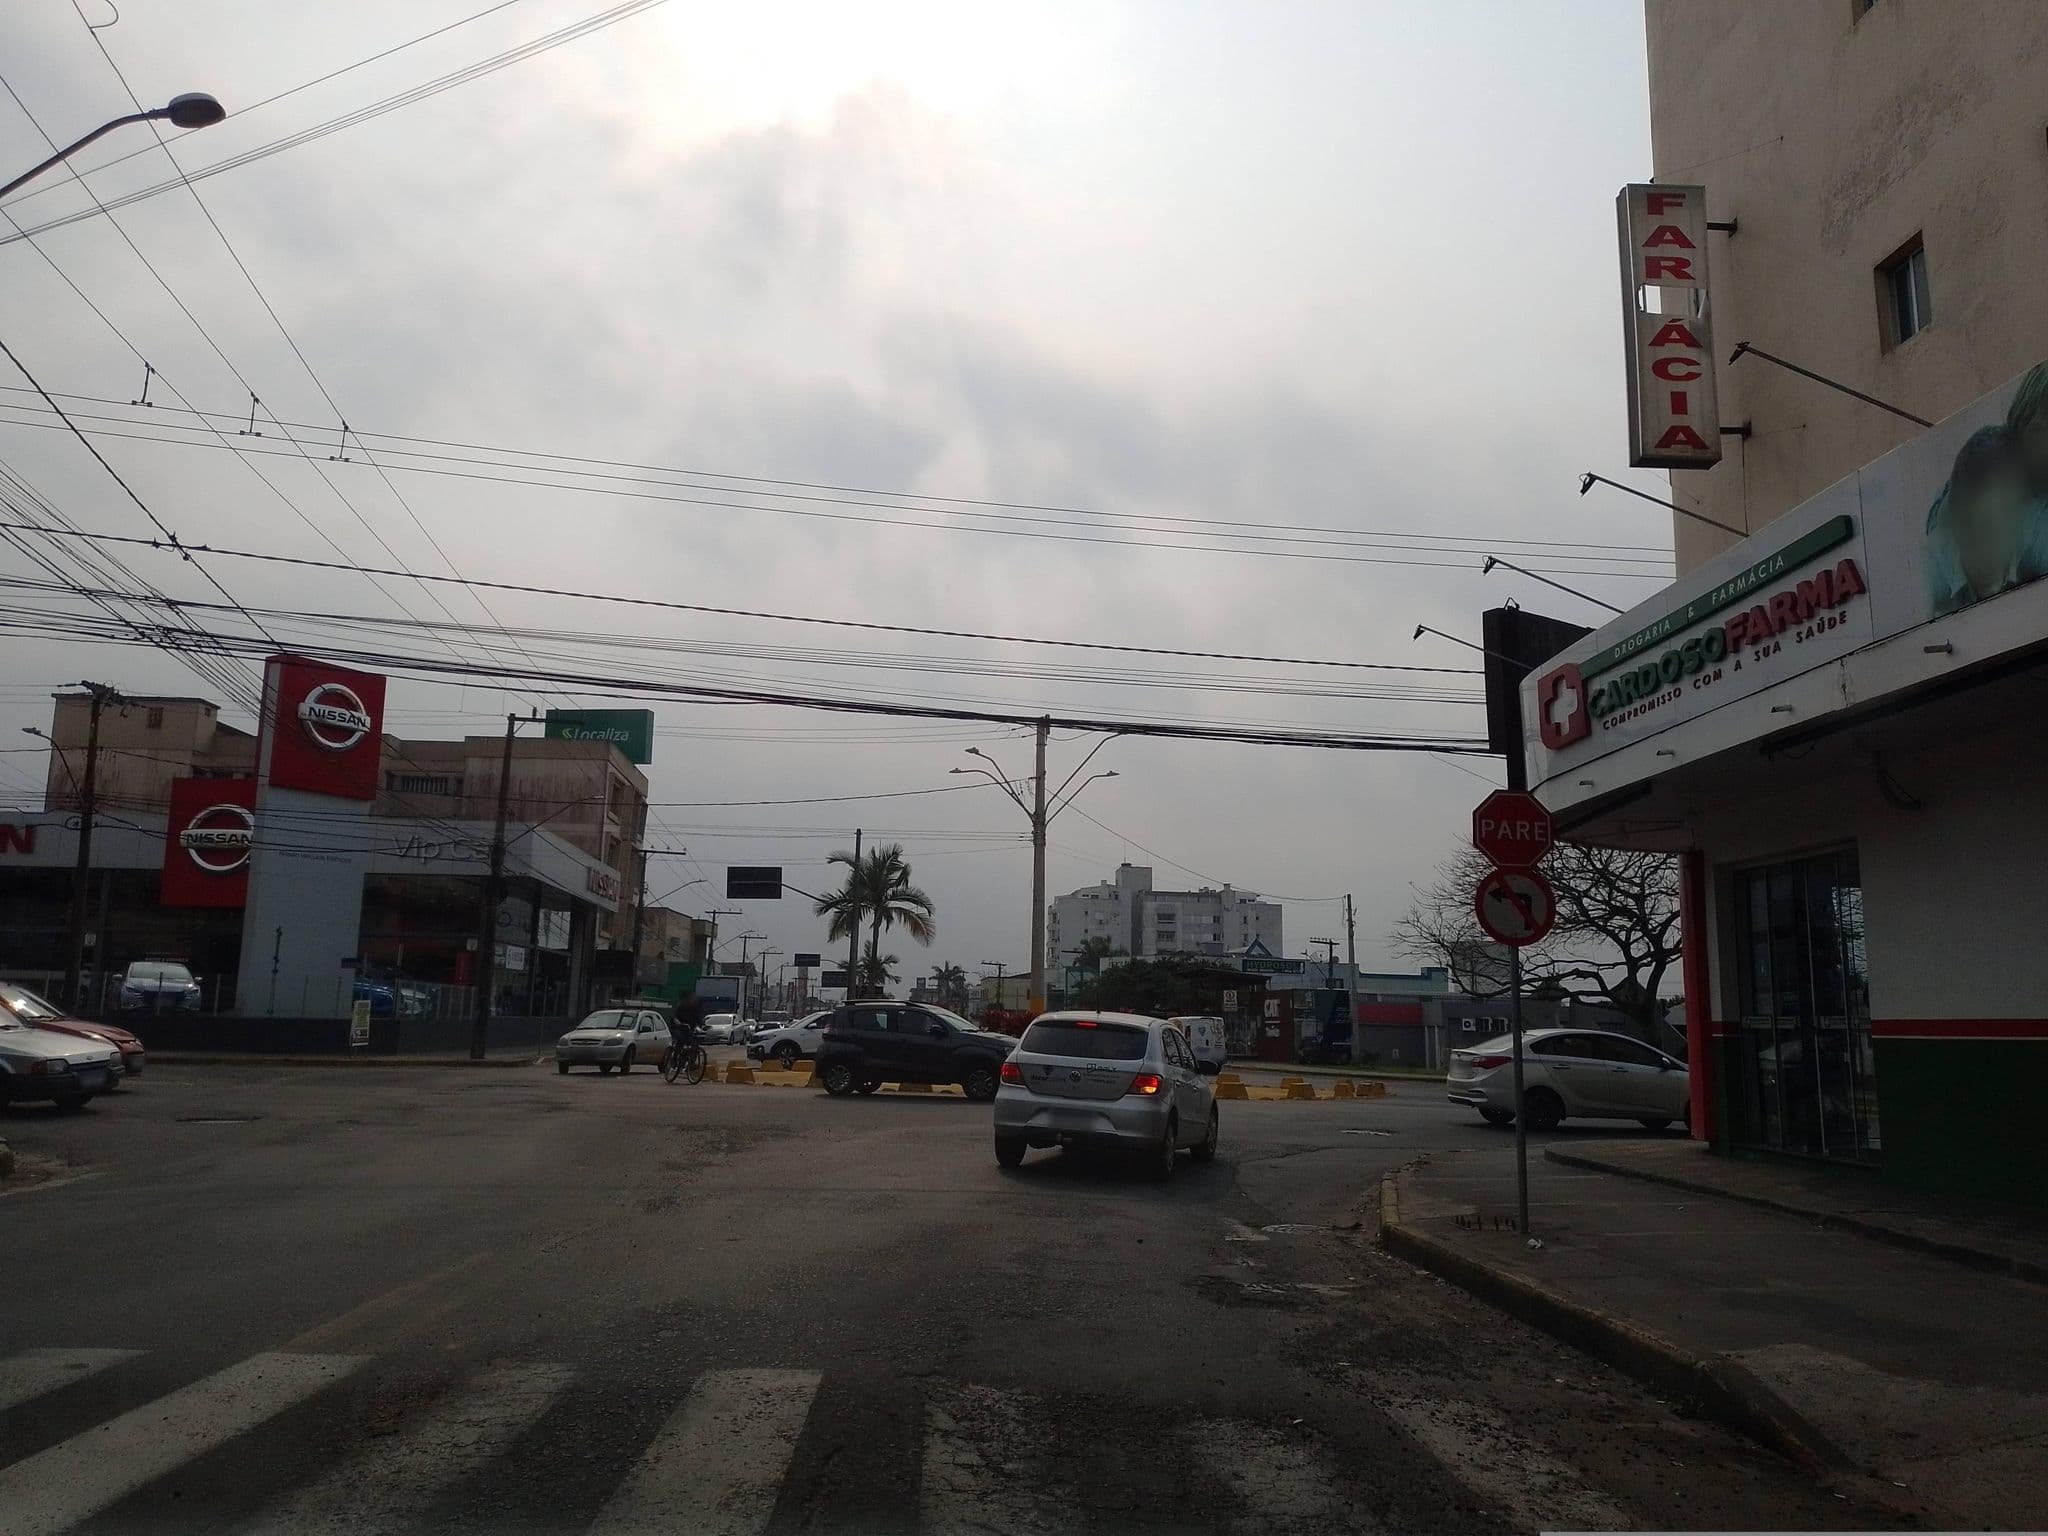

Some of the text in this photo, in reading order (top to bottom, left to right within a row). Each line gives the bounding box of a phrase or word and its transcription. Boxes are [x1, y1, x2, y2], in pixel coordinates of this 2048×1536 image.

[1642, 193, 1711, 449] FARÁCIA
[1614, 555, 1785, 658] DROGARIA & FARMÁCIA
[1603, 610, 1847, 730] COMPROMISSO COM A SUA SAÚDE
[308, 707, 366, 727] NISSAN
[186, 833, 252, 844] NISSAN
[1481, 819, 1547, 841] PARE
[391, 834, 440, 865] Vip
